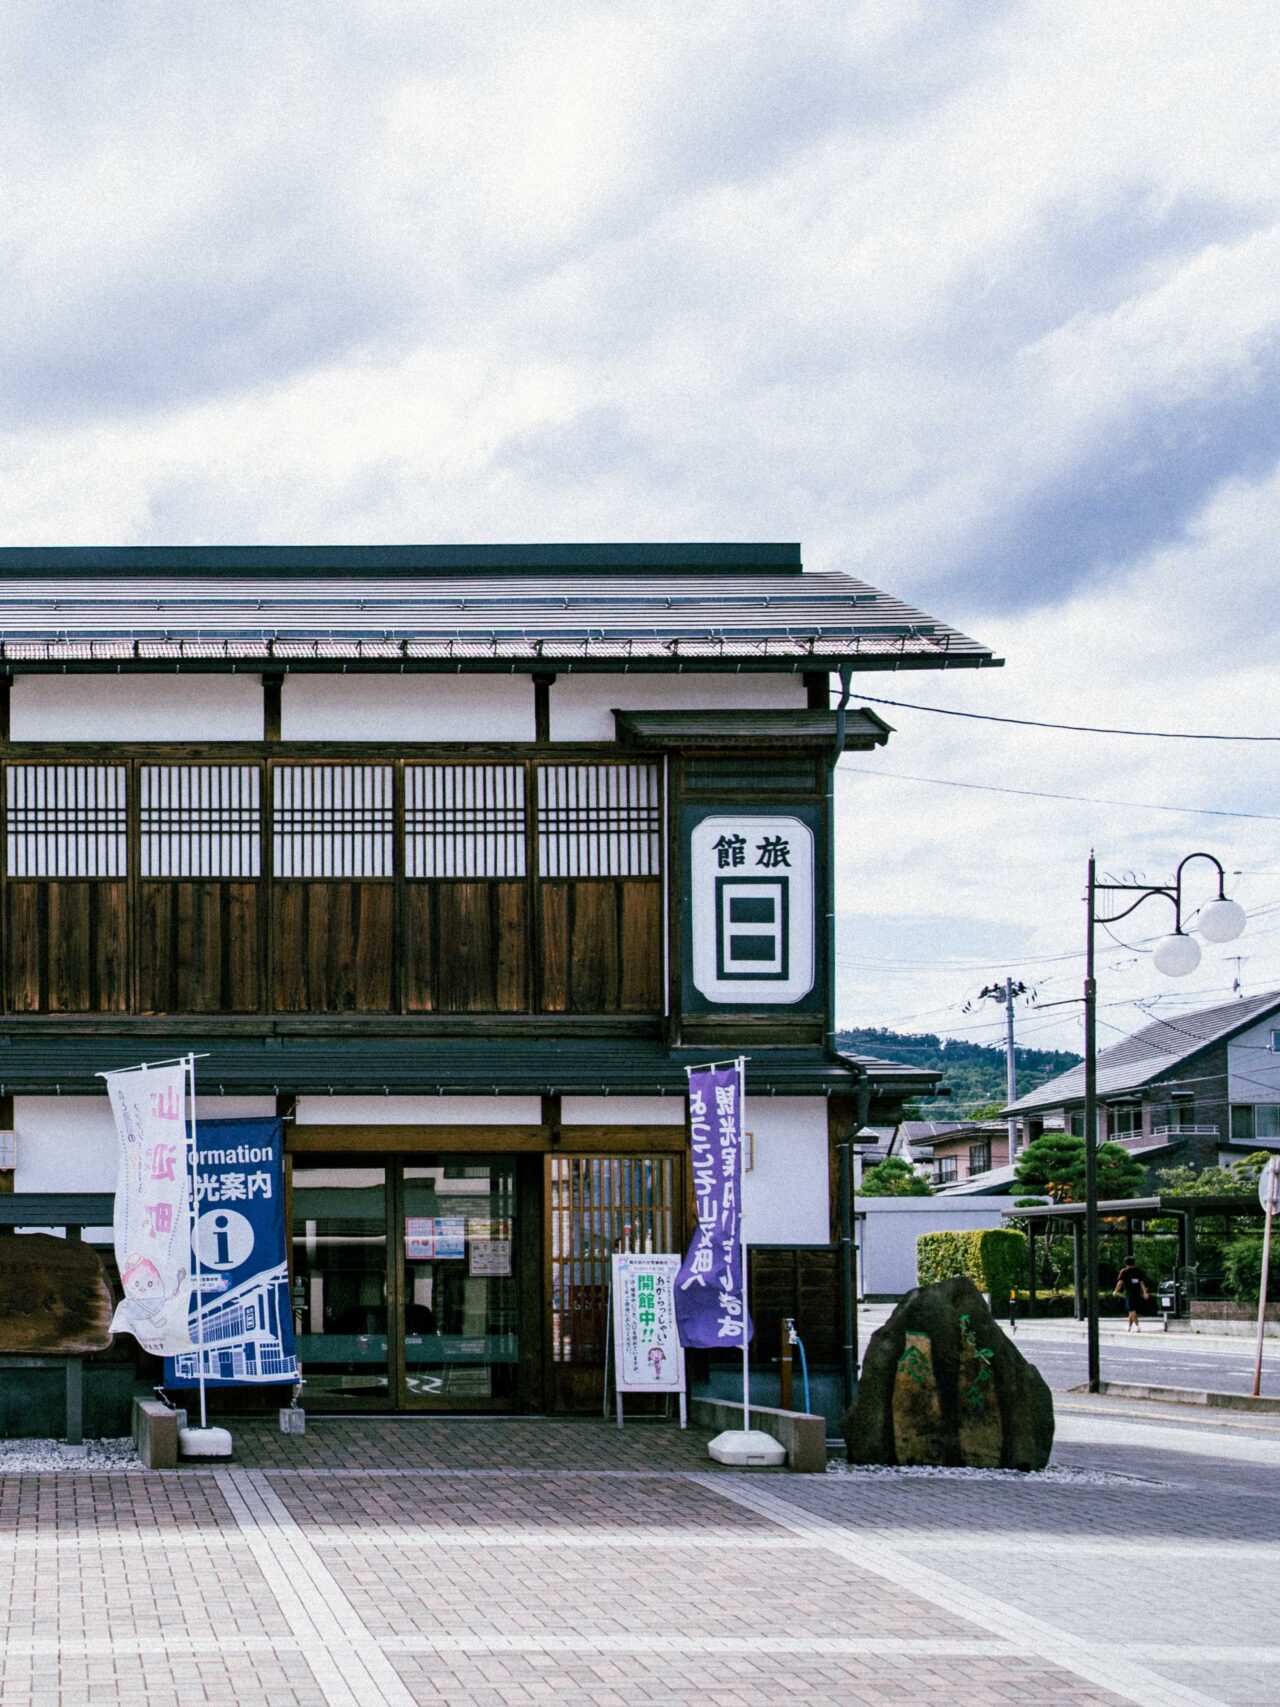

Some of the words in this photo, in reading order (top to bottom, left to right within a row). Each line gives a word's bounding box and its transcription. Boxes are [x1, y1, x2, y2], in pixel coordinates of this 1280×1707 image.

[188, 1145, 273, 1166] ormation
[187, 1170, 273, 1203] 光案内
